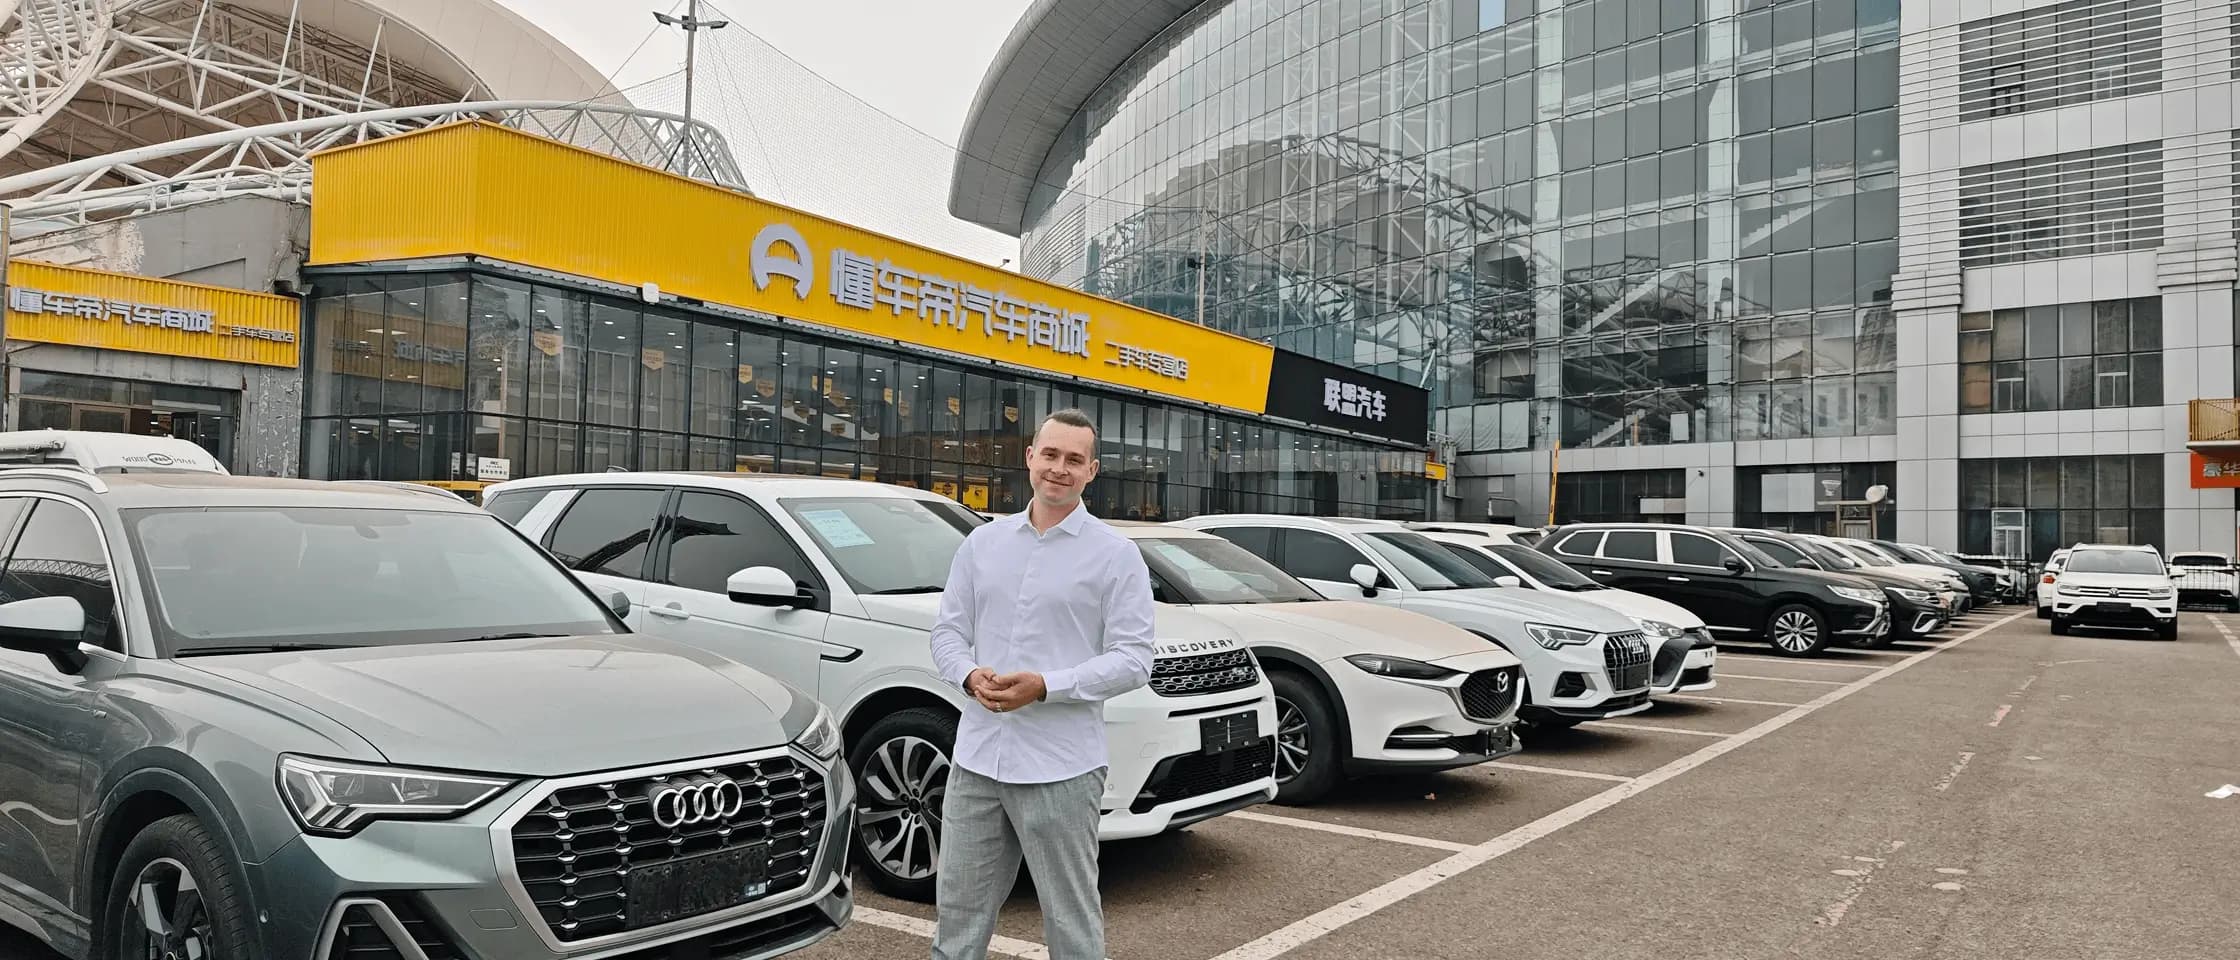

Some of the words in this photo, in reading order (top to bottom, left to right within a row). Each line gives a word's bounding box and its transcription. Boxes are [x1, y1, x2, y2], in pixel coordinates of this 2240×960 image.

[9, 287, 215, 333] 懂车帝汽车商城
[828, 248, 1092, 358] 懂车帝汽车商城
[1324, 377, 1387, 421] 联盟汽车
